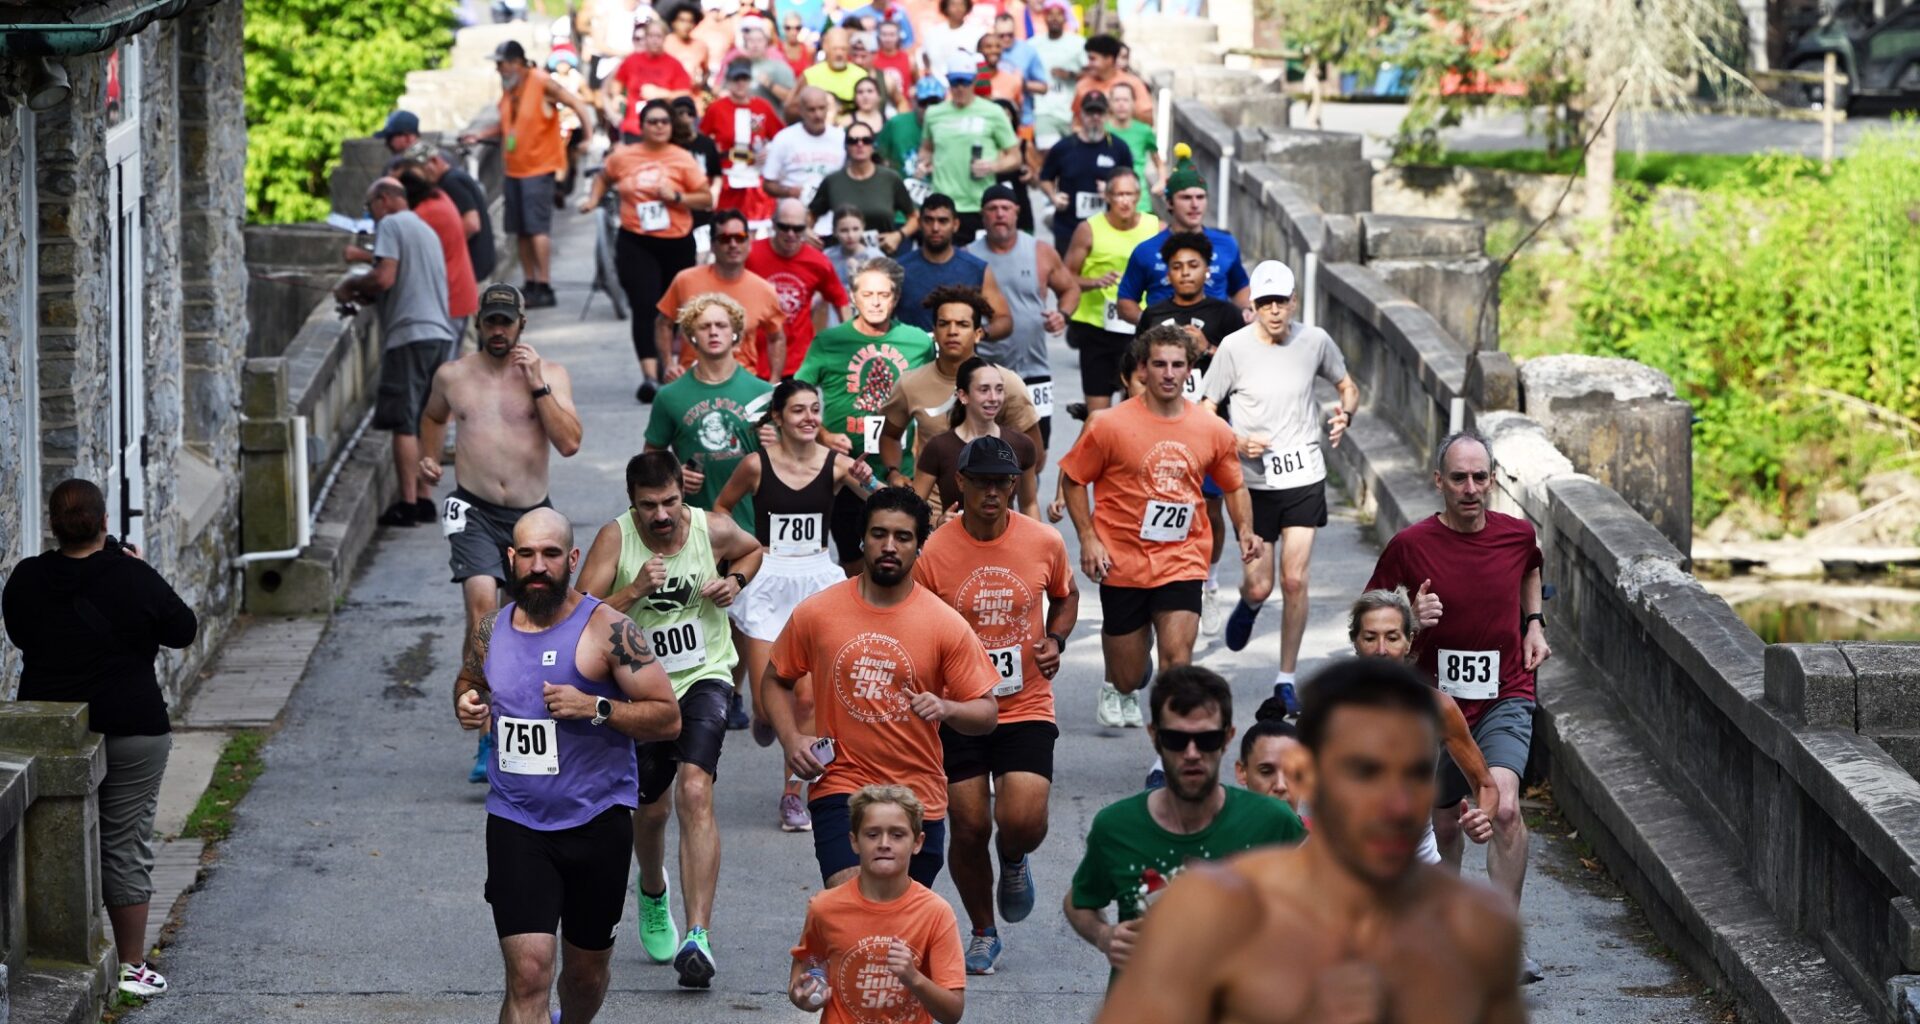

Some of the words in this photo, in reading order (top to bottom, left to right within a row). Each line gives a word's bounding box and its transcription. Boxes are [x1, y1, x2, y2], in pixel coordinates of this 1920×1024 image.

[1033, 386, 1053, 406] 86
[1271, 450, 1304, 475] 861
[1151, 505, 1188, 528] 726
[778, 517, 815, 541] 780
[972, 598, 1014, 613] July
[652, 623, 697, 657] 800
[854, 656, 896, 670] Jingle
[1447, 655, 1491, 683] 853
[850, 666, 895, 686] July
[504, 721, 547, 756] 750
[858, 963, 892, 975] Jing
[856, 974, 904, 992] July
